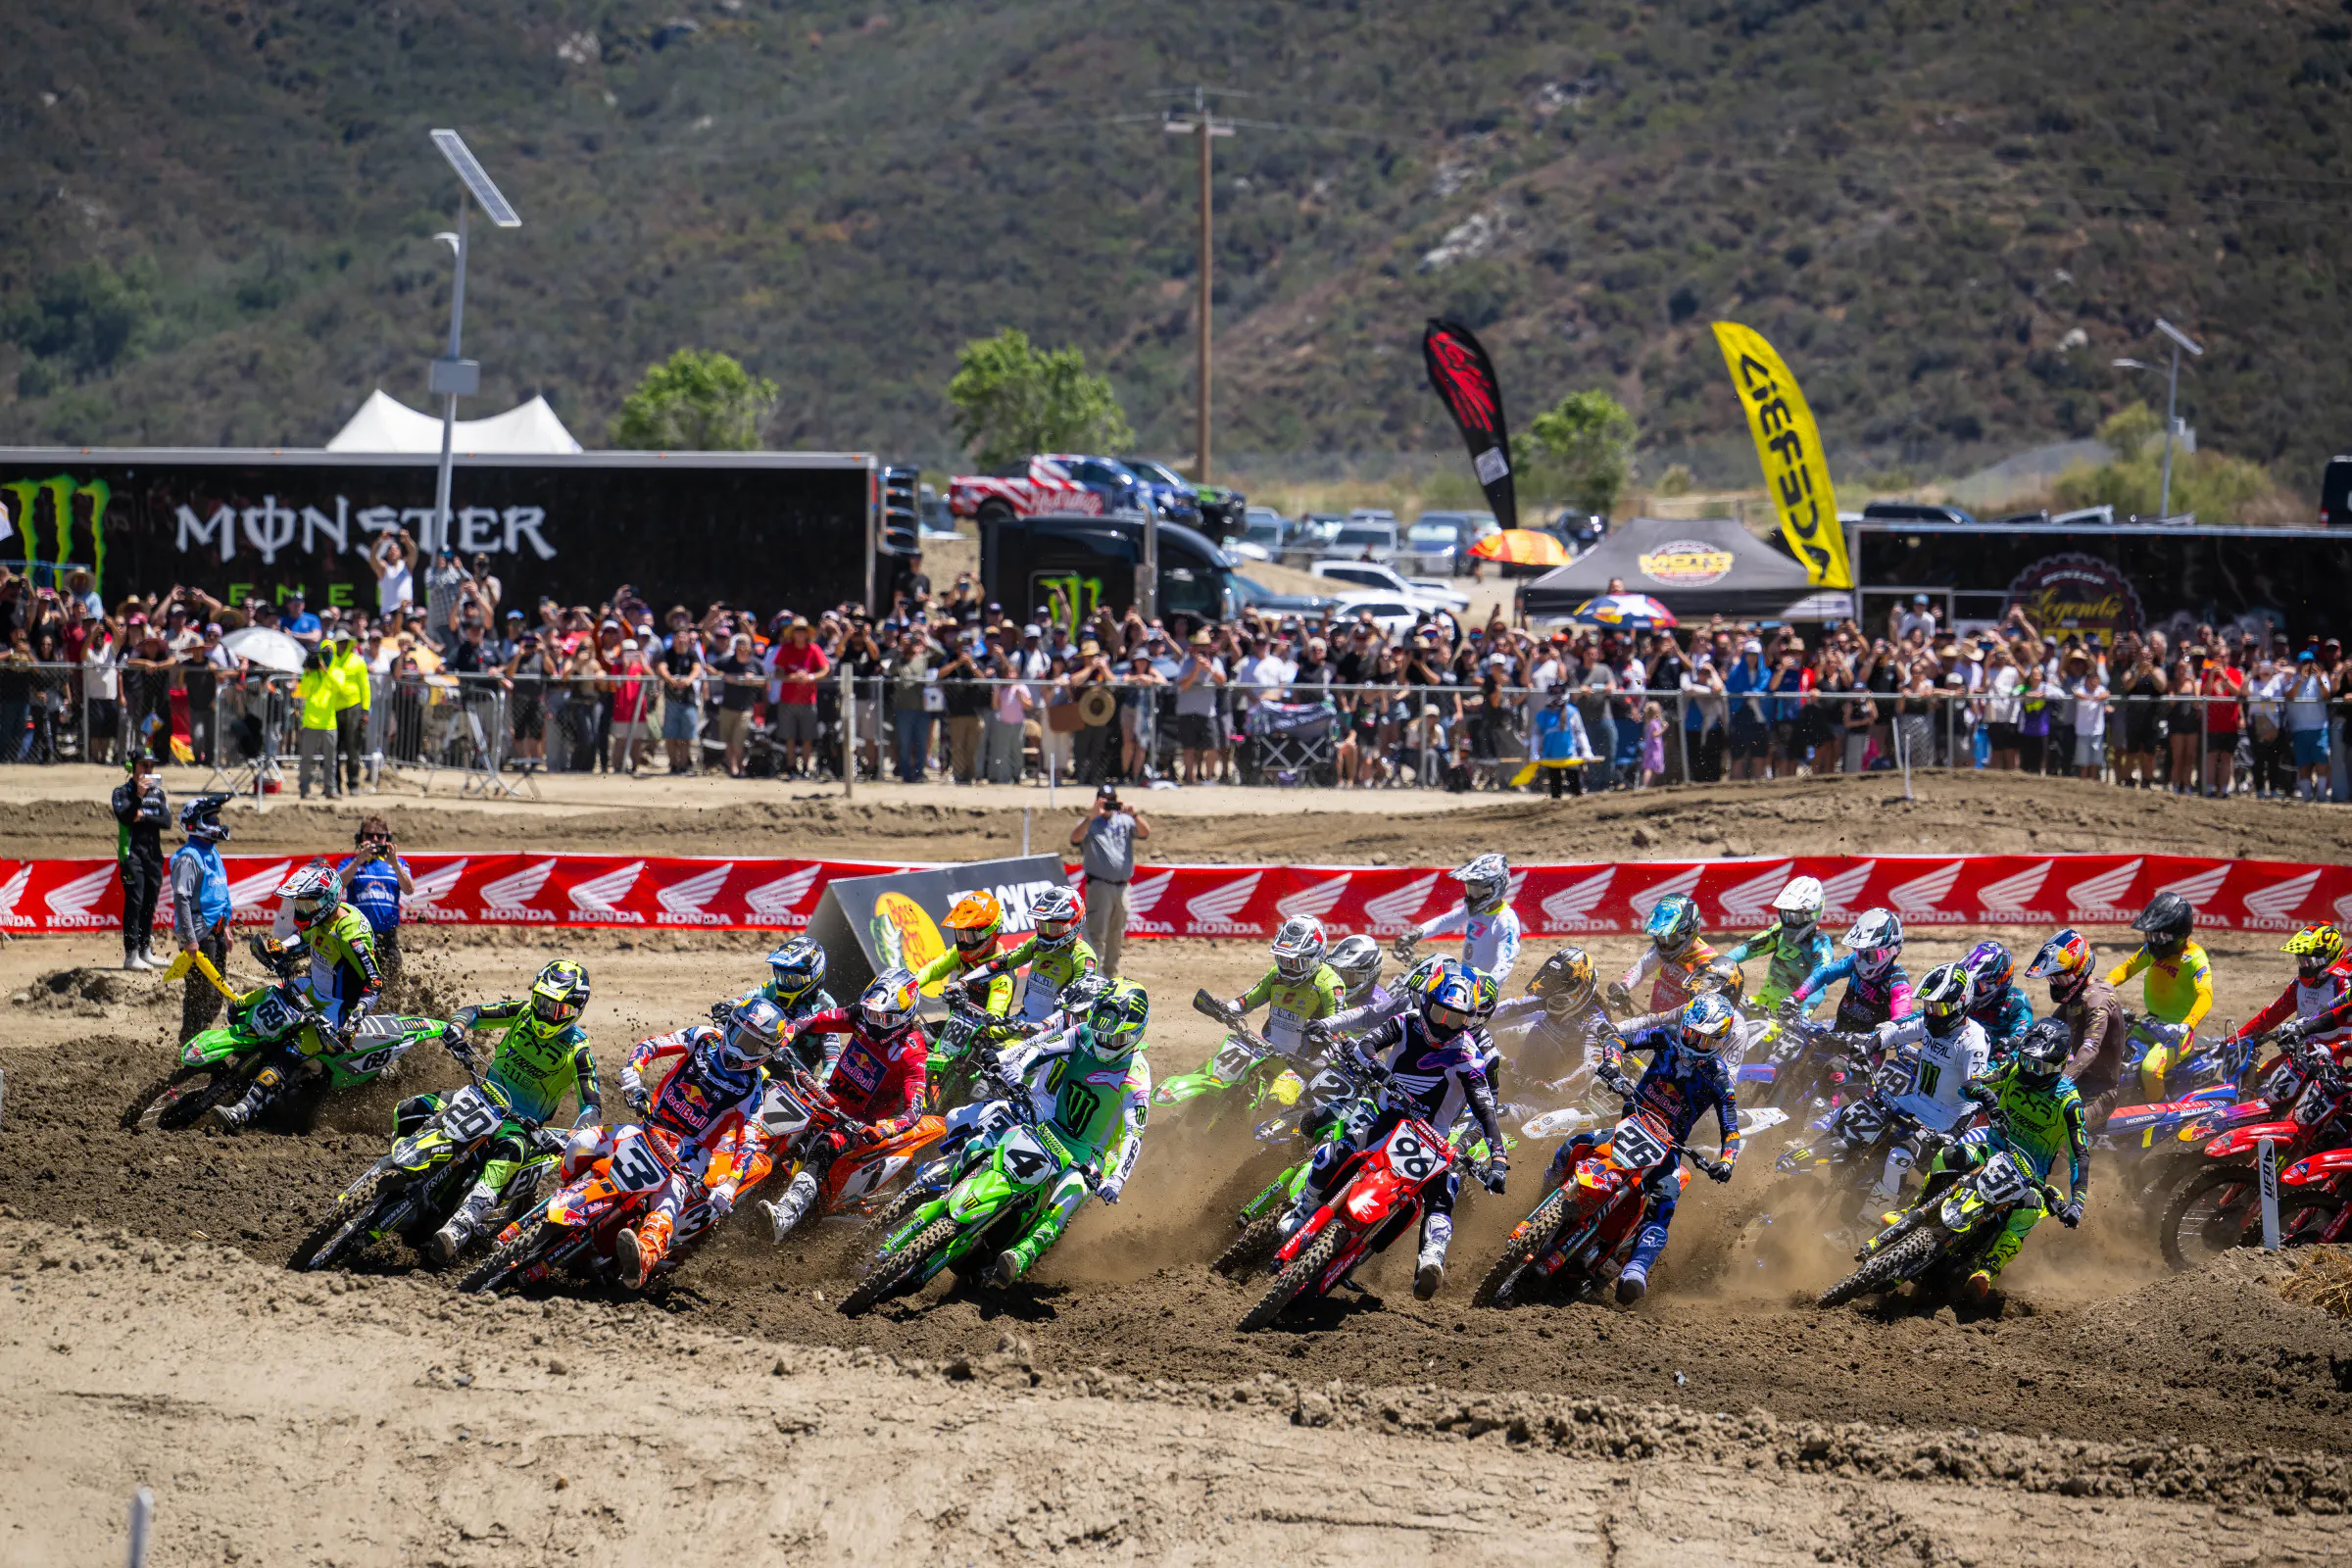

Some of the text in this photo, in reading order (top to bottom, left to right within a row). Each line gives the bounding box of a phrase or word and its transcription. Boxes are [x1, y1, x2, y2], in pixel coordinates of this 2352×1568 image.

[174, 494, 558, 565] MONSTER
[0, 915, 36, 927] NDA
[46, 914, 122, 927] HONDA
[480, 907, 557, 922] HONDA
[568, 908, 645, 924] HONDA
[656, 910, 733, 925] HONDA
[745, 912, 811, 926] HOND
[1186, 921, 1263, 935] HONDA
[1543, 919, 1621, 932] HONDA
[1720, 912, 1781, 925] HOND
[1979, 910, 2055, 922] HONDA
[256, 1000, 288, 1031] 69
[362, 1048, 393, 1070] 69
[1923, 1034, 1951, 1059] ONEAL
[501, 1061, 521, 1084] 5.11
[839, 1057, 876, 1093] Red Bull
[1214, 1048, 1252, 1076] 41
[664, 1087, 709, 1129] Red Bull
[763, 1095, 808, 1125] 7
[1645, 1084, 1664, 1102] Red
[1661, 1097, 1682, 1116] Bull
[444, 1096, 493, 1138] 20
[2125, 1114, 2156, 1125] HONDA
[1417, 1124, 1444, 1149] RENTHAL
[1421, 1119, 1447, 1145] RENTHAL
[1394, 1136, 1430, 1180] 96
[1615, 1125, 1663, 1167] 26
[610, 1147, 661, 1192] 3
[1007, 1148, 1046, 1178] 4
[2264, 1164, 2273, 1199] UFO
[677, 1204, 713, 1236] 3
[1283, 1218, 1316, 1252] DUNLOP
[1324, 1253, 1357, 1291] DUNLOP
